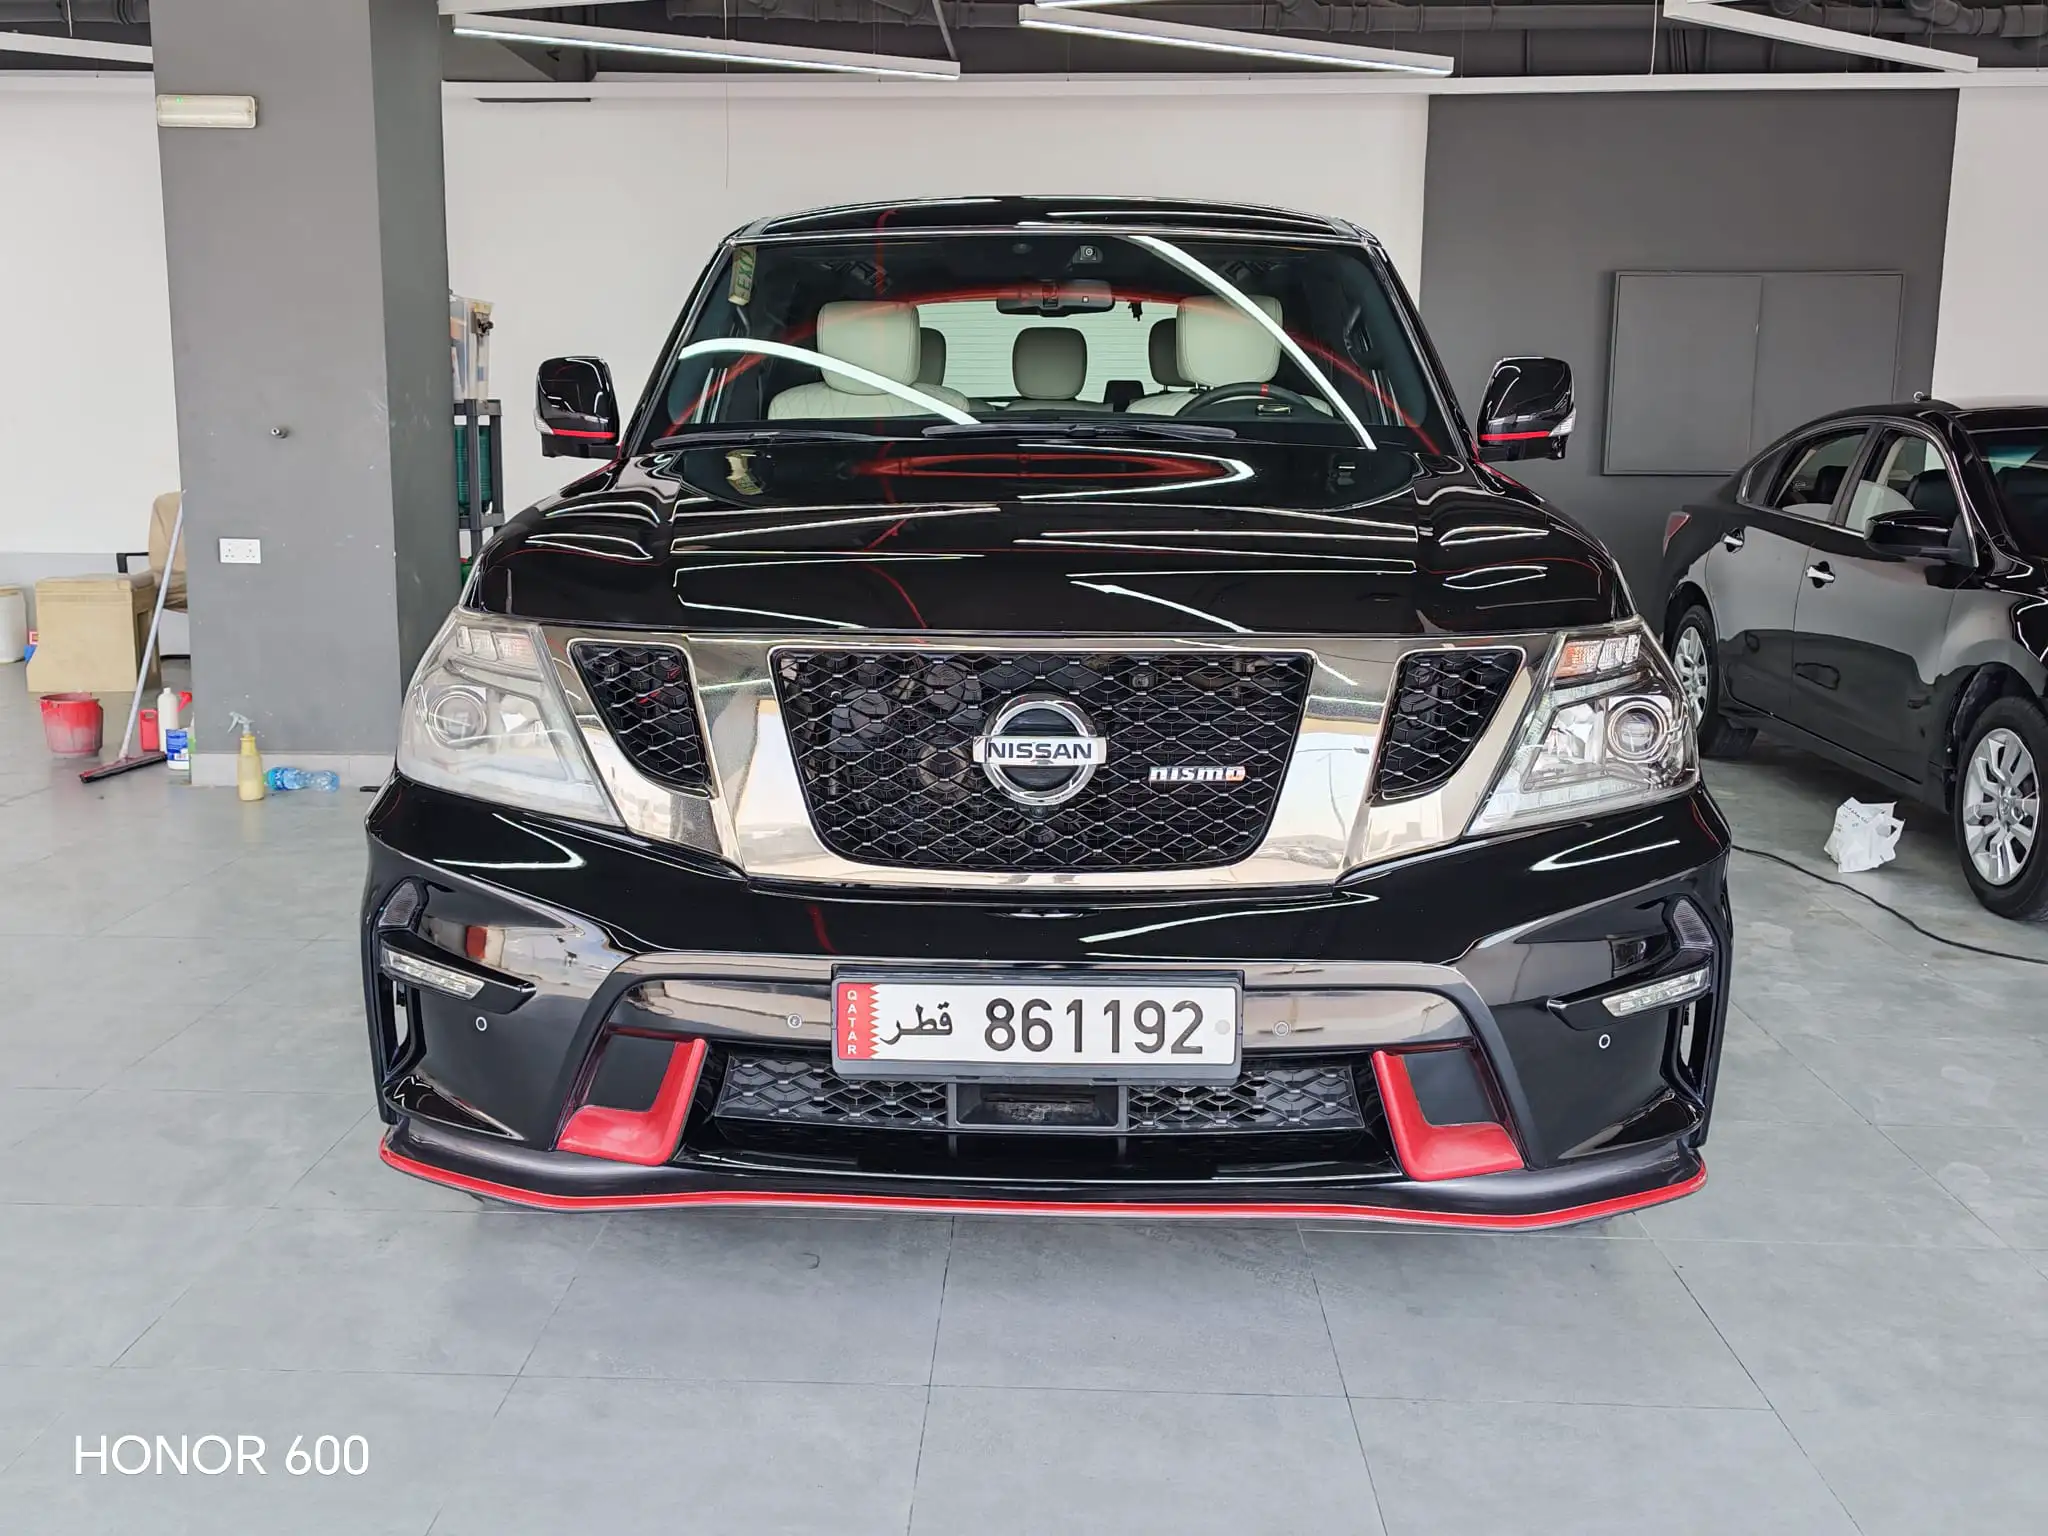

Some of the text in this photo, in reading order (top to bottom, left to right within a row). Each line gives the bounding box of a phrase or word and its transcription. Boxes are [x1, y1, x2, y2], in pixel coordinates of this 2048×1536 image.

[987, 742, 1092, 760] NISSAN
[846, 989, 858, 1055] QATAR
[879, 1001, 953, 1046] قطر
[984, 997, 1204, 1054] 861192
